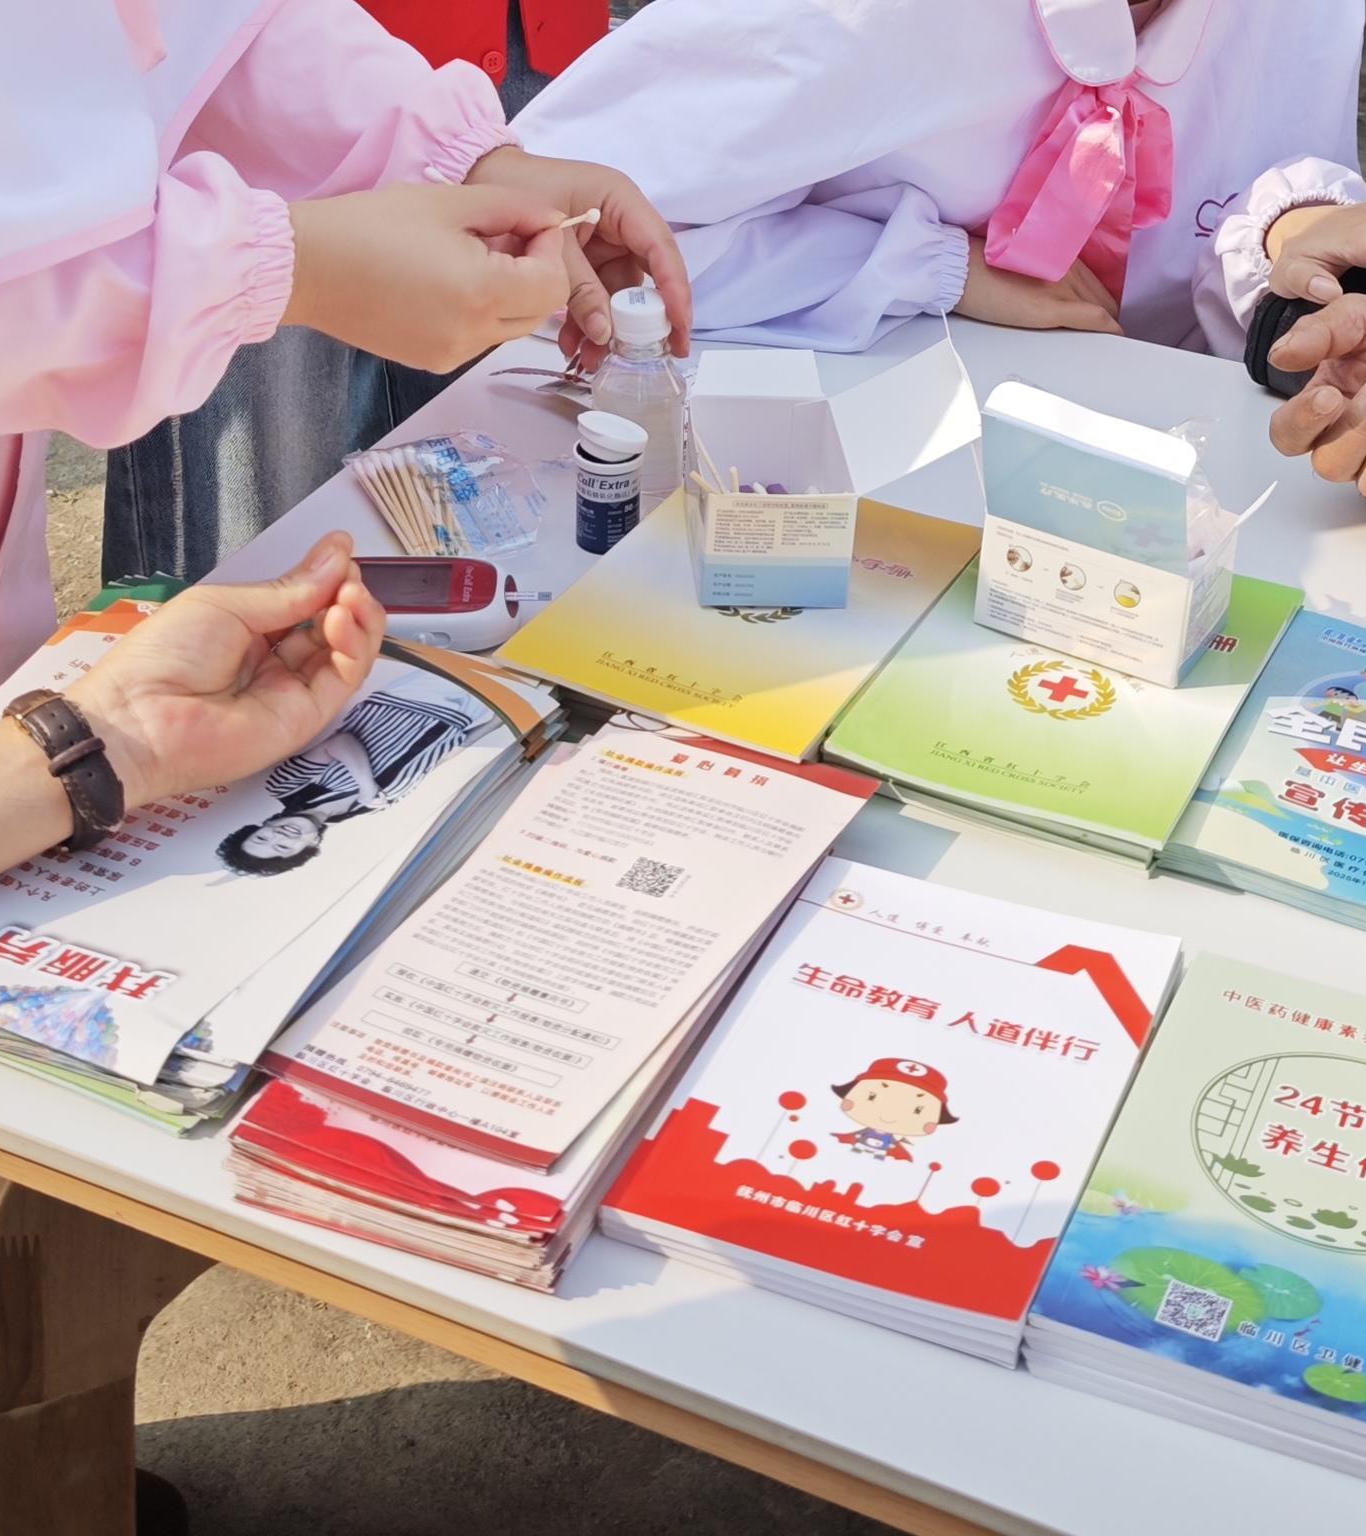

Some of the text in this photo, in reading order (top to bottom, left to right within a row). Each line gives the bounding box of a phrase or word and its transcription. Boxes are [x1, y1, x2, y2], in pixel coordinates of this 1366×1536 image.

[599, 479, 630, 490] Extra
[790, 961, 1102, 1062] 生命教育 人道伴行
